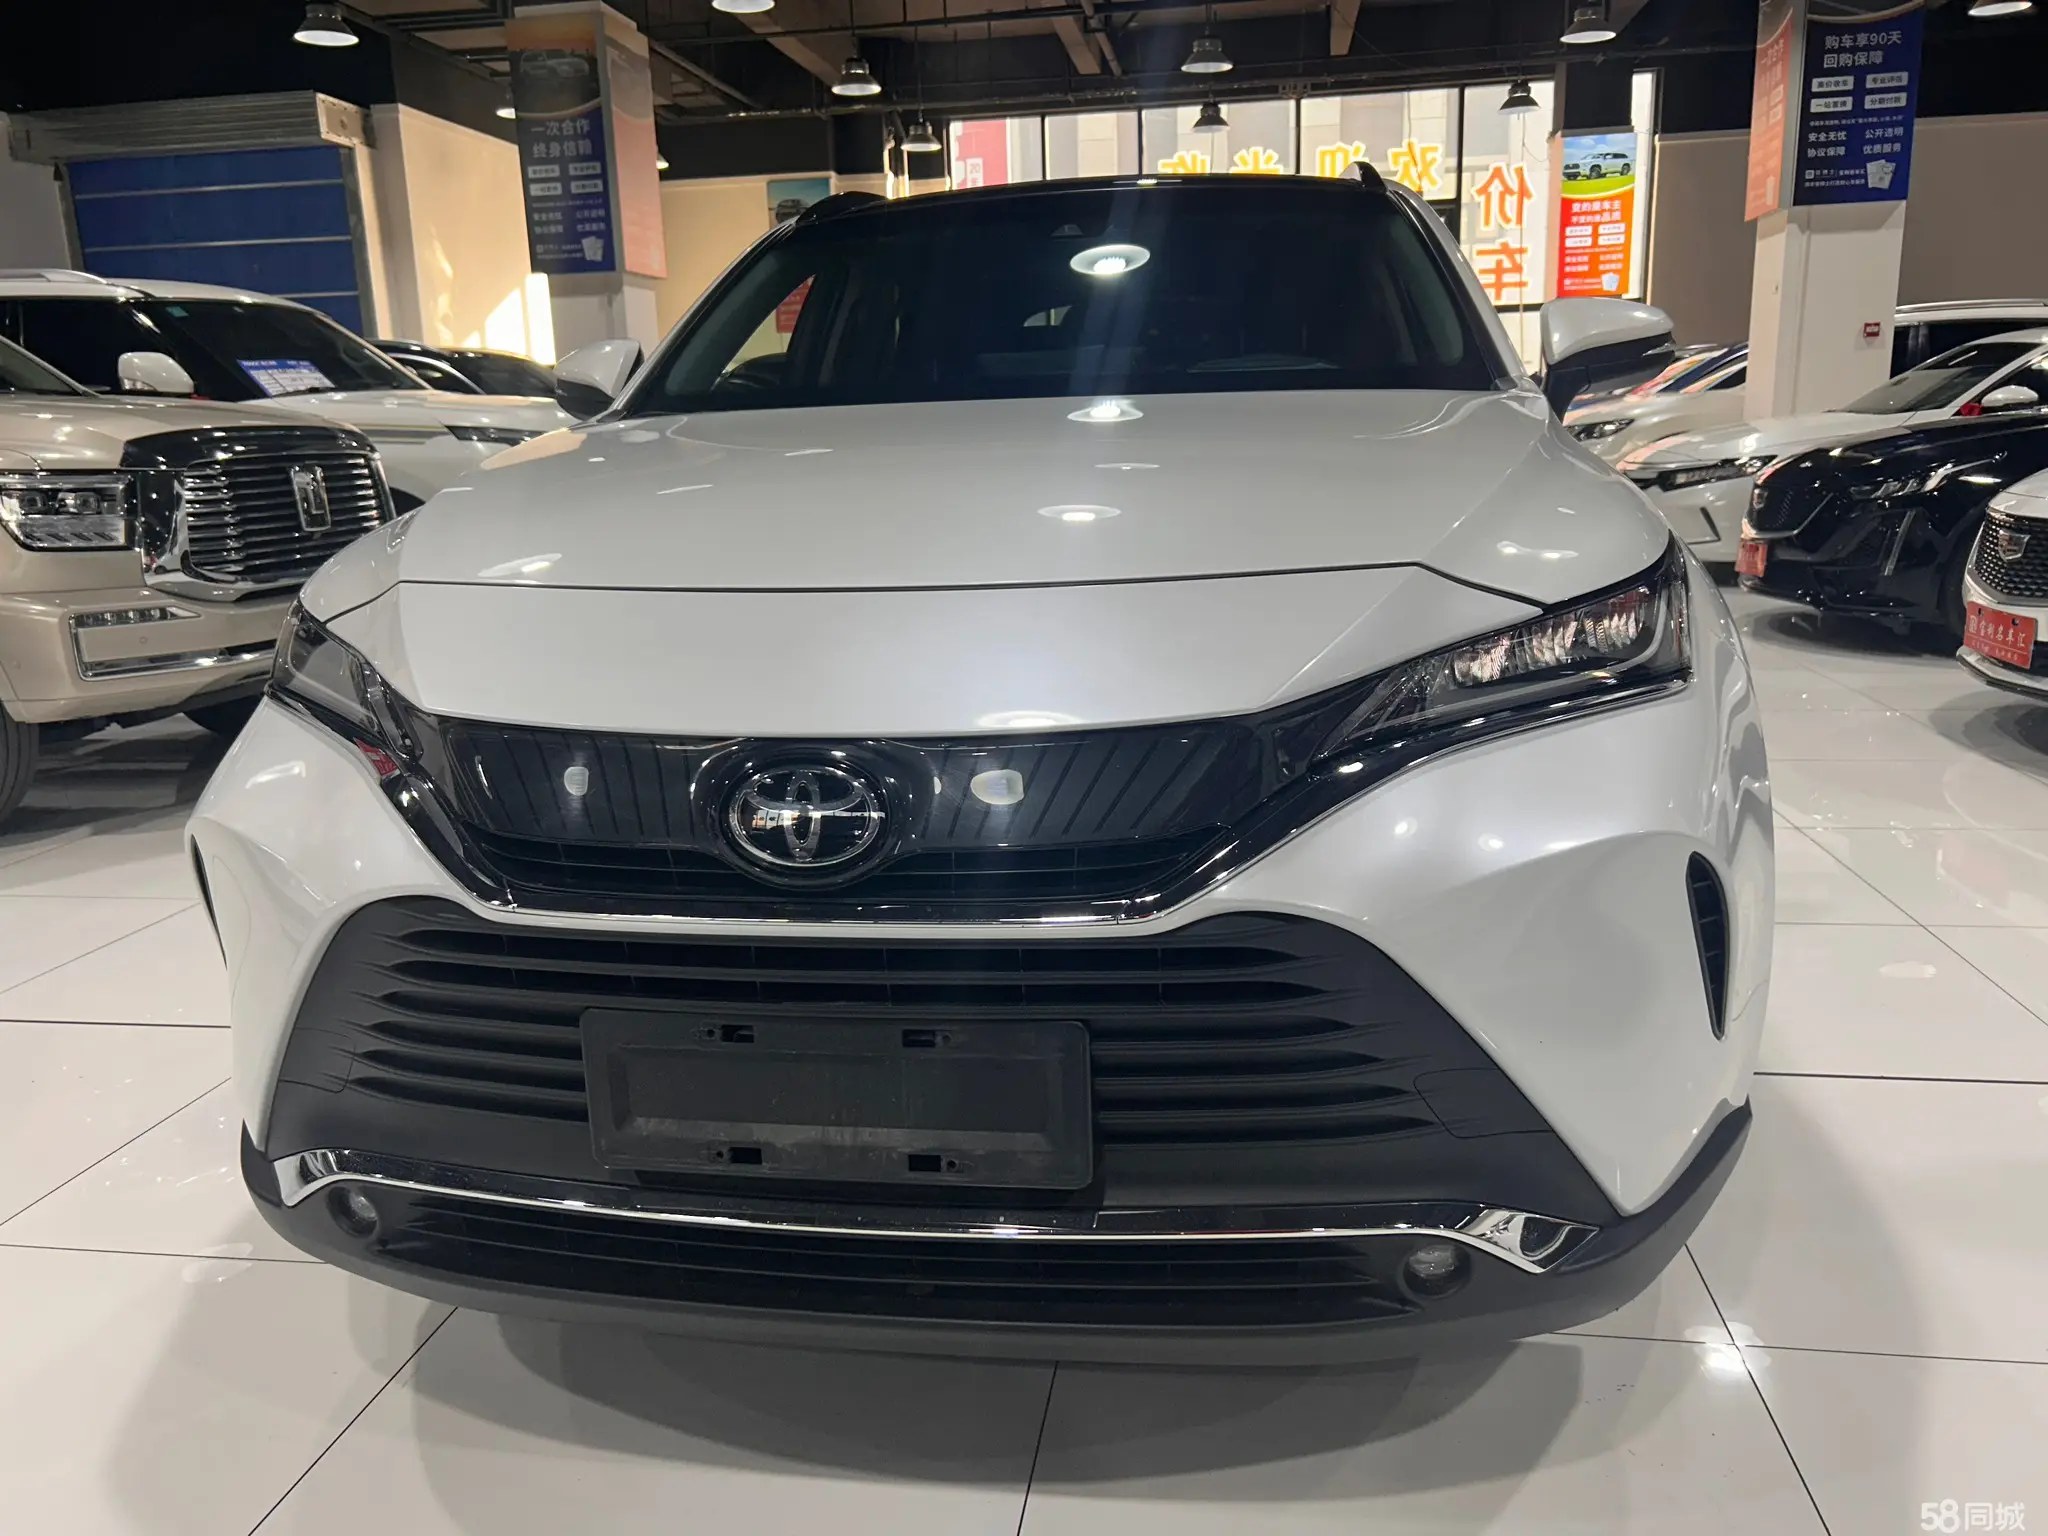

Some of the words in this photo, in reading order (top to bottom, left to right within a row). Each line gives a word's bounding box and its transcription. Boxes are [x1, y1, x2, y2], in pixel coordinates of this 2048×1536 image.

[1824, 31, 1902, 49] 购车享90天
[1823, 50, 1884, 68] 回购保障
[530, 119, 590, 136] 一次合作
[1865, 126, 1904, 139] 公开透明
[1808, 131, 1847, 142] 安全无忧
[532, 138, 593, 158] 终身信赖
[1807, 146, 1846, 158] 协议保障
[1862, 142, 1902, 154] 优质服务
